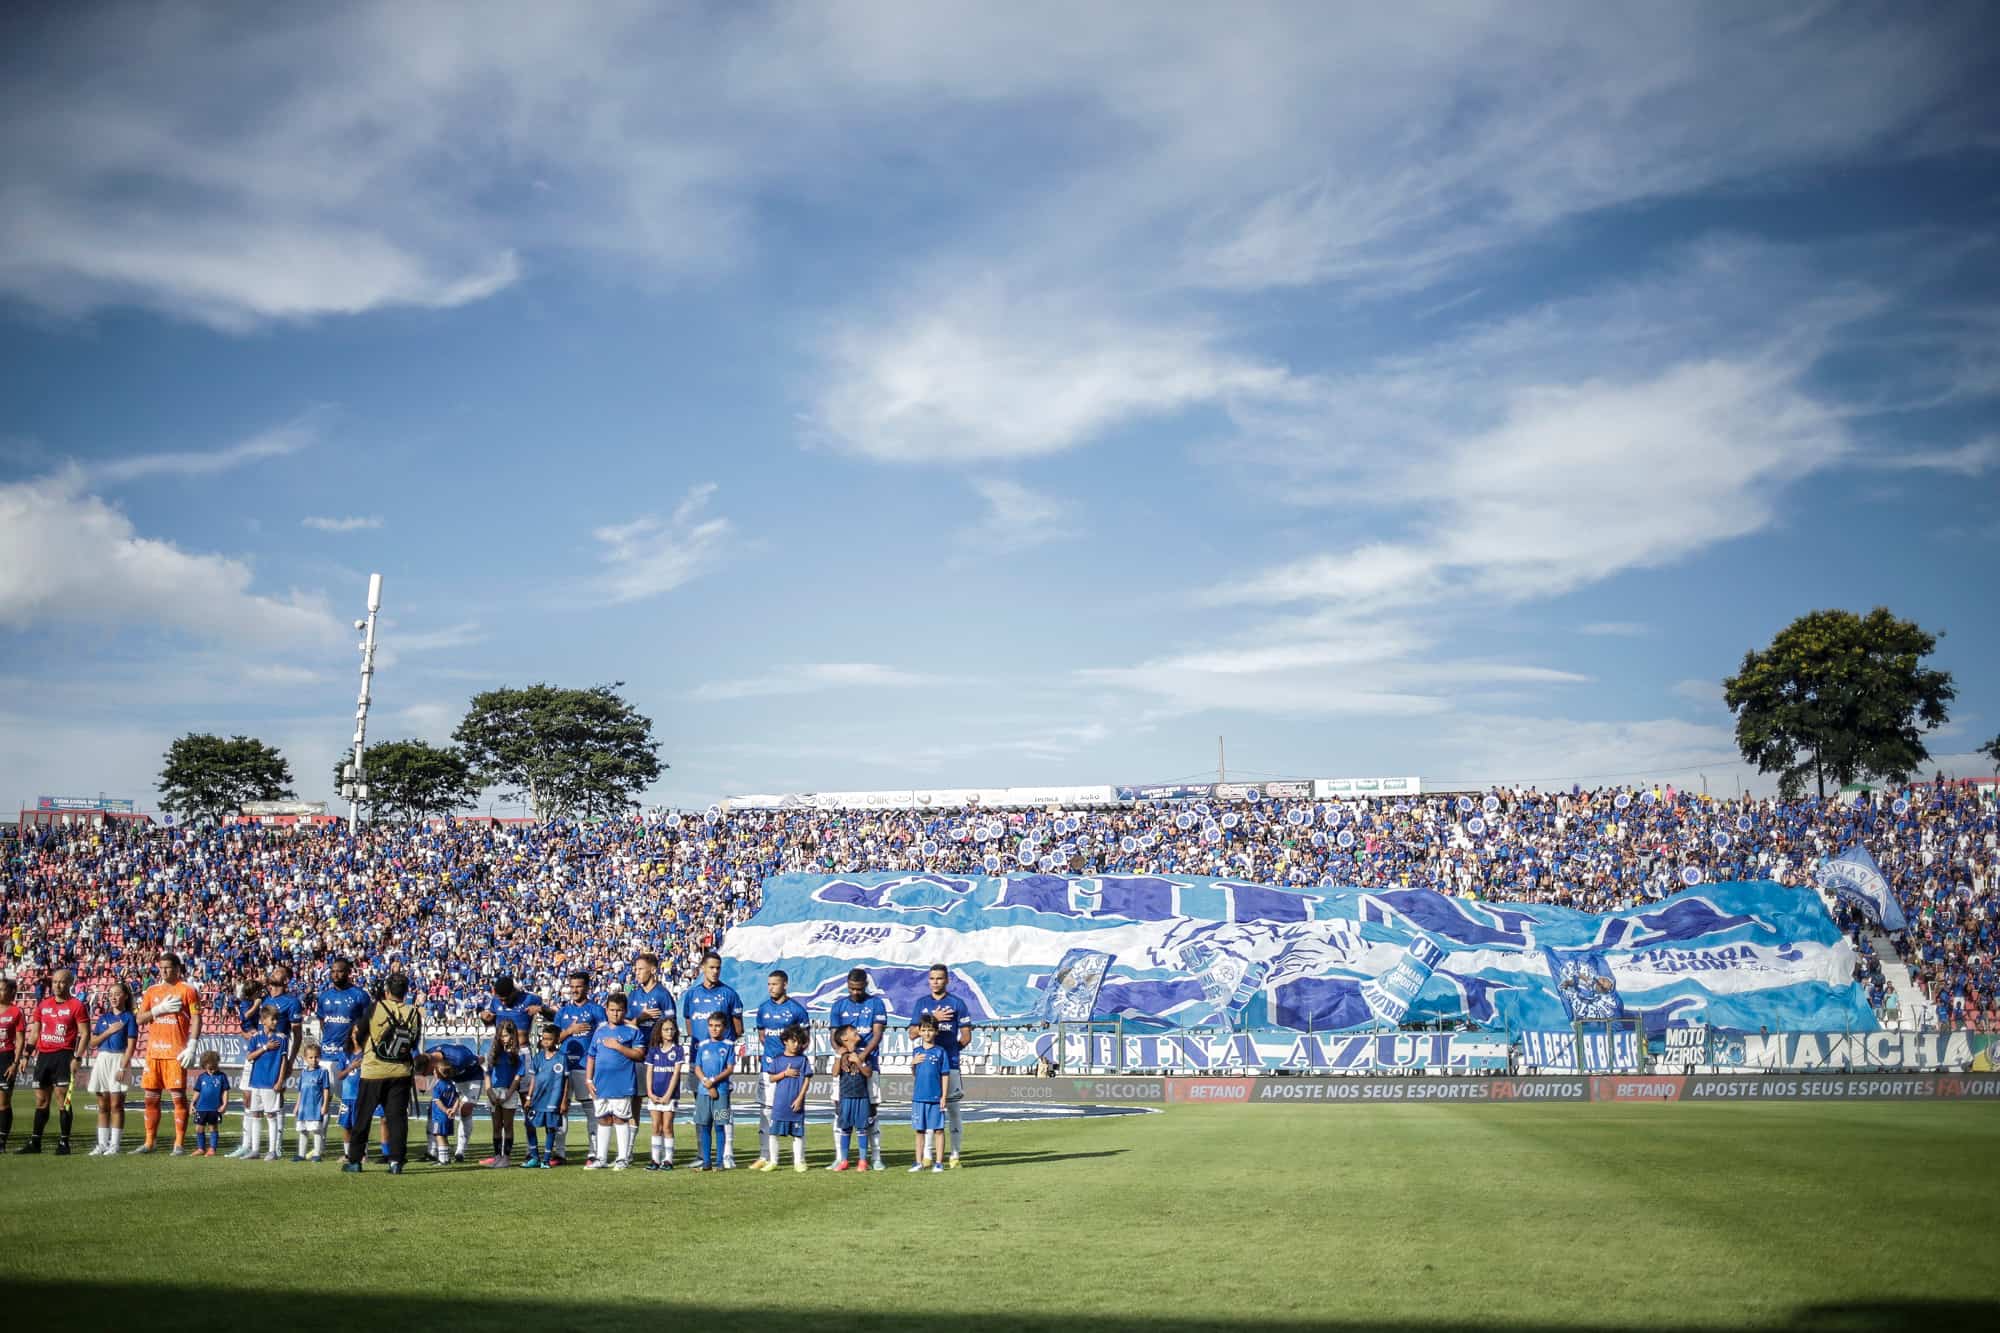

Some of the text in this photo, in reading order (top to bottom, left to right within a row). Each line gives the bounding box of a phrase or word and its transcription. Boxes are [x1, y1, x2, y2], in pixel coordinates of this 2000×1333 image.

[1666, 1028, 1706, 1046] MOTO
[1035, 1033, 1267, 1069] CHINA
[1280, 1033, 1469, 1069] AZUL
[1543, 1032, 1595, 1068] BESTA
[1664, 1047, 1706, 1065] ZEIROS
[1743, 1032, 1974, 1069] MANCHA
[1095, 1083, 1161, 1099] SICOOB
[1189, 1085, 1246, 1099] BETANO
[1260, 1081, 1583, 1098] APOSTE NOS SEUS ESPORTES FAVORITOS
[1616, 1082, 1676, 1097] BETANO
[1692, 1078, 2000, 1097] APOSTE NOS SEUS ESPORTES FAVORI
